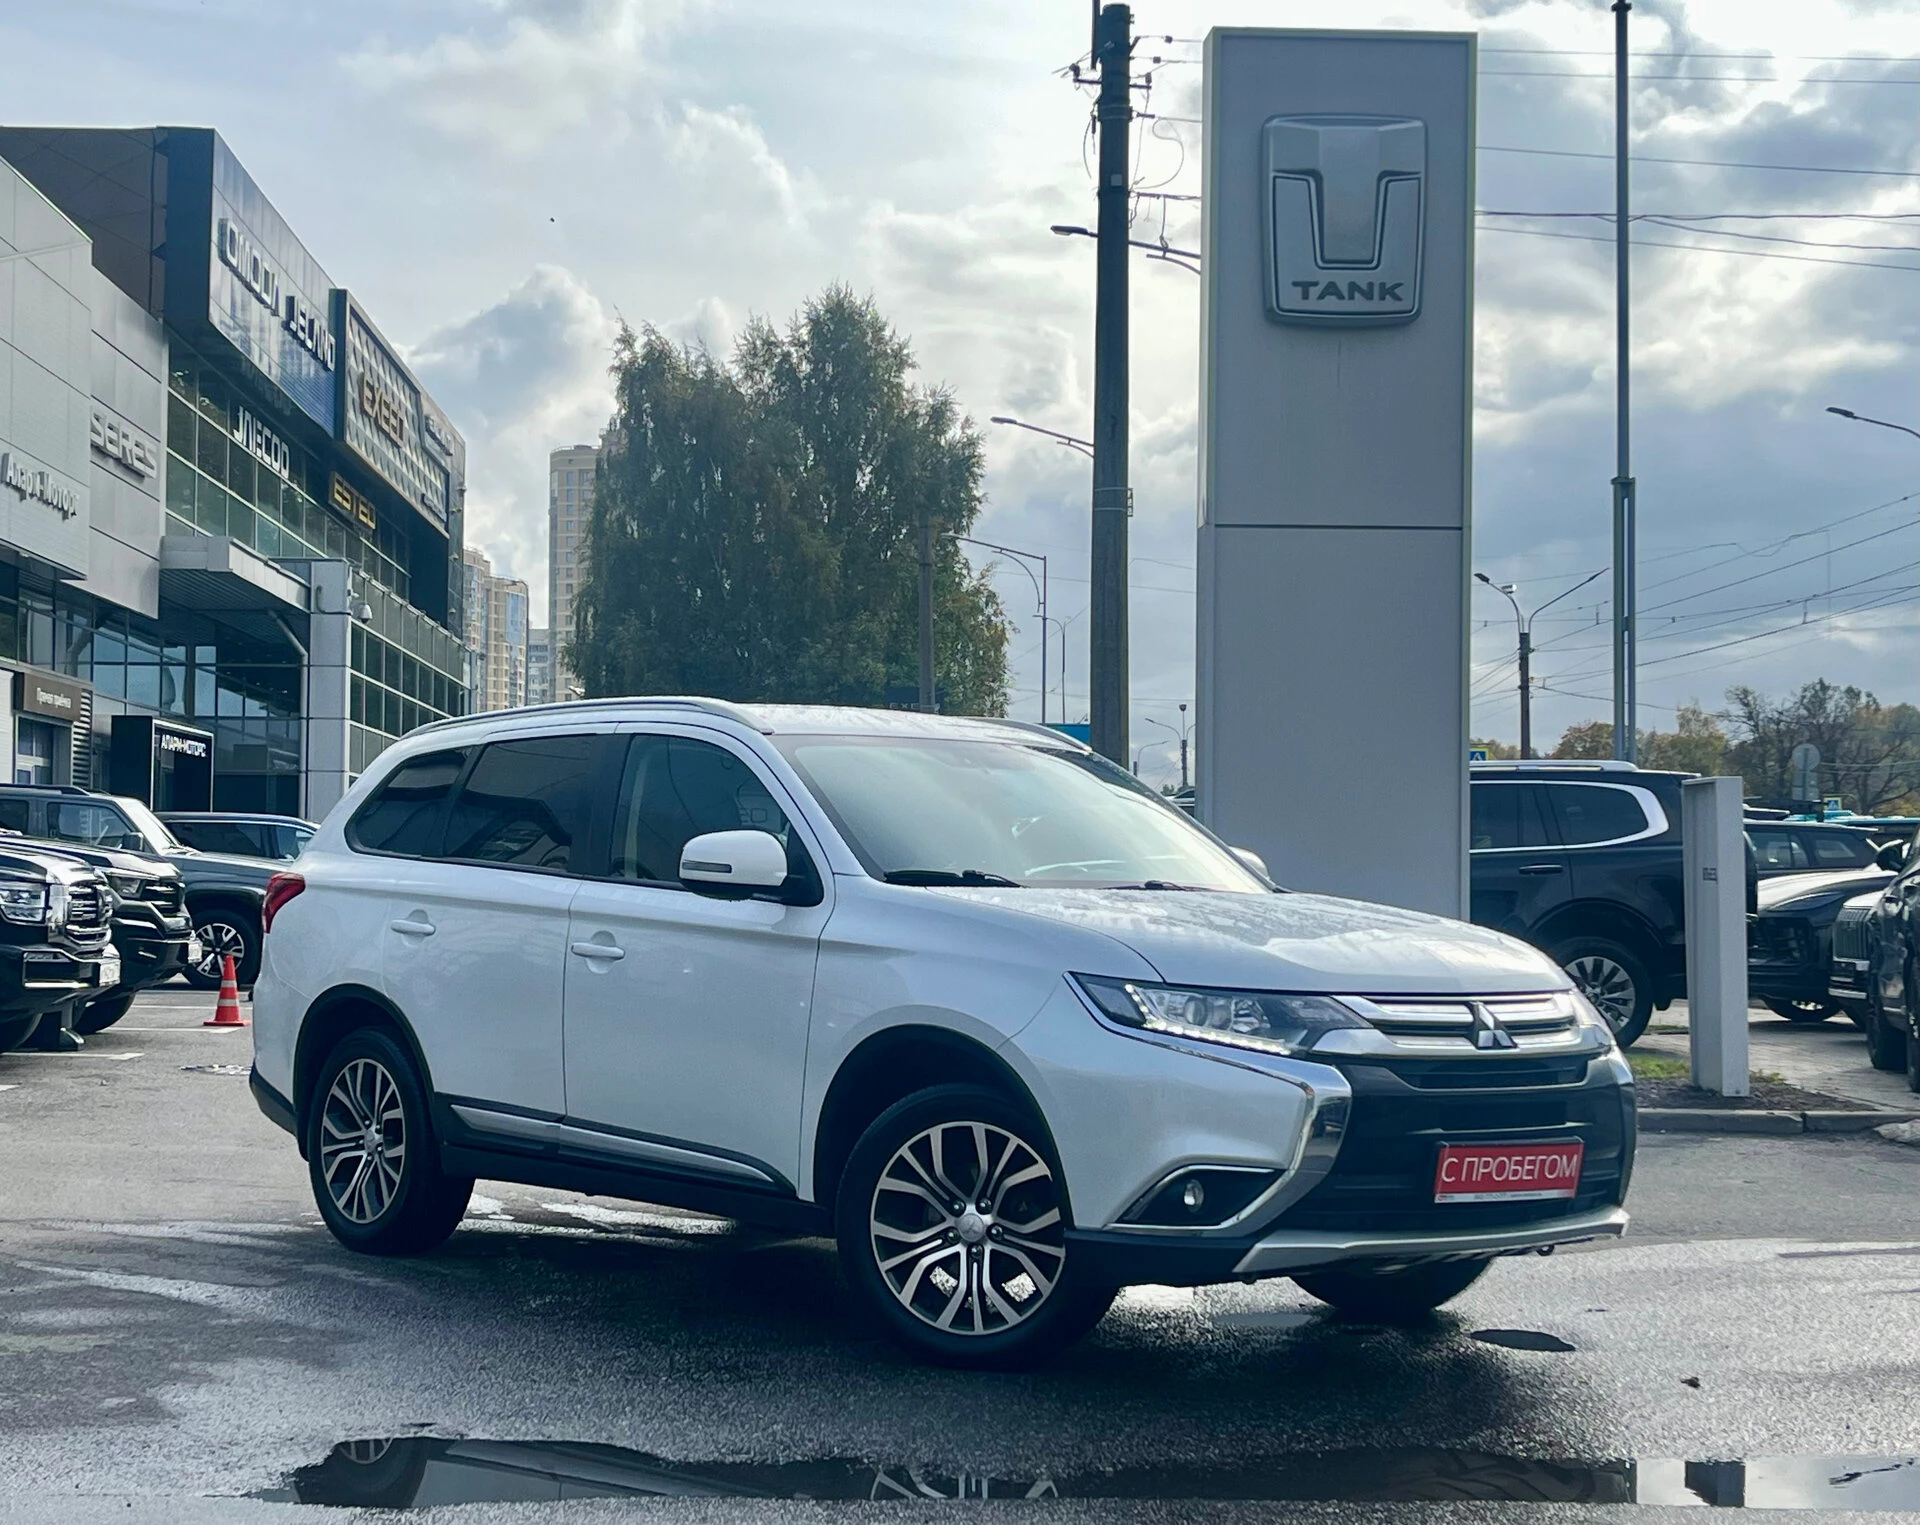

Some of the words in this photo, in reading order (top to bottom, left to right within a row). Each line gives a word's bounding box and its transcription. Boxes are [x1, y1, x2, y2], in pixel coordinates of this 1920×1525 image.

[218, 218, 280, 316] OMODA
[1291, 280, 1405, 302] TANK
[233, 406, 290, 480] JAECOO
[358, 372, 404, 448] EXEED
[91, 412, 158, 480] SERES
[1441, 1157, 1459, 1182] С
[1461, 1154, 1578, 1182] ПРОБЕГОМ
